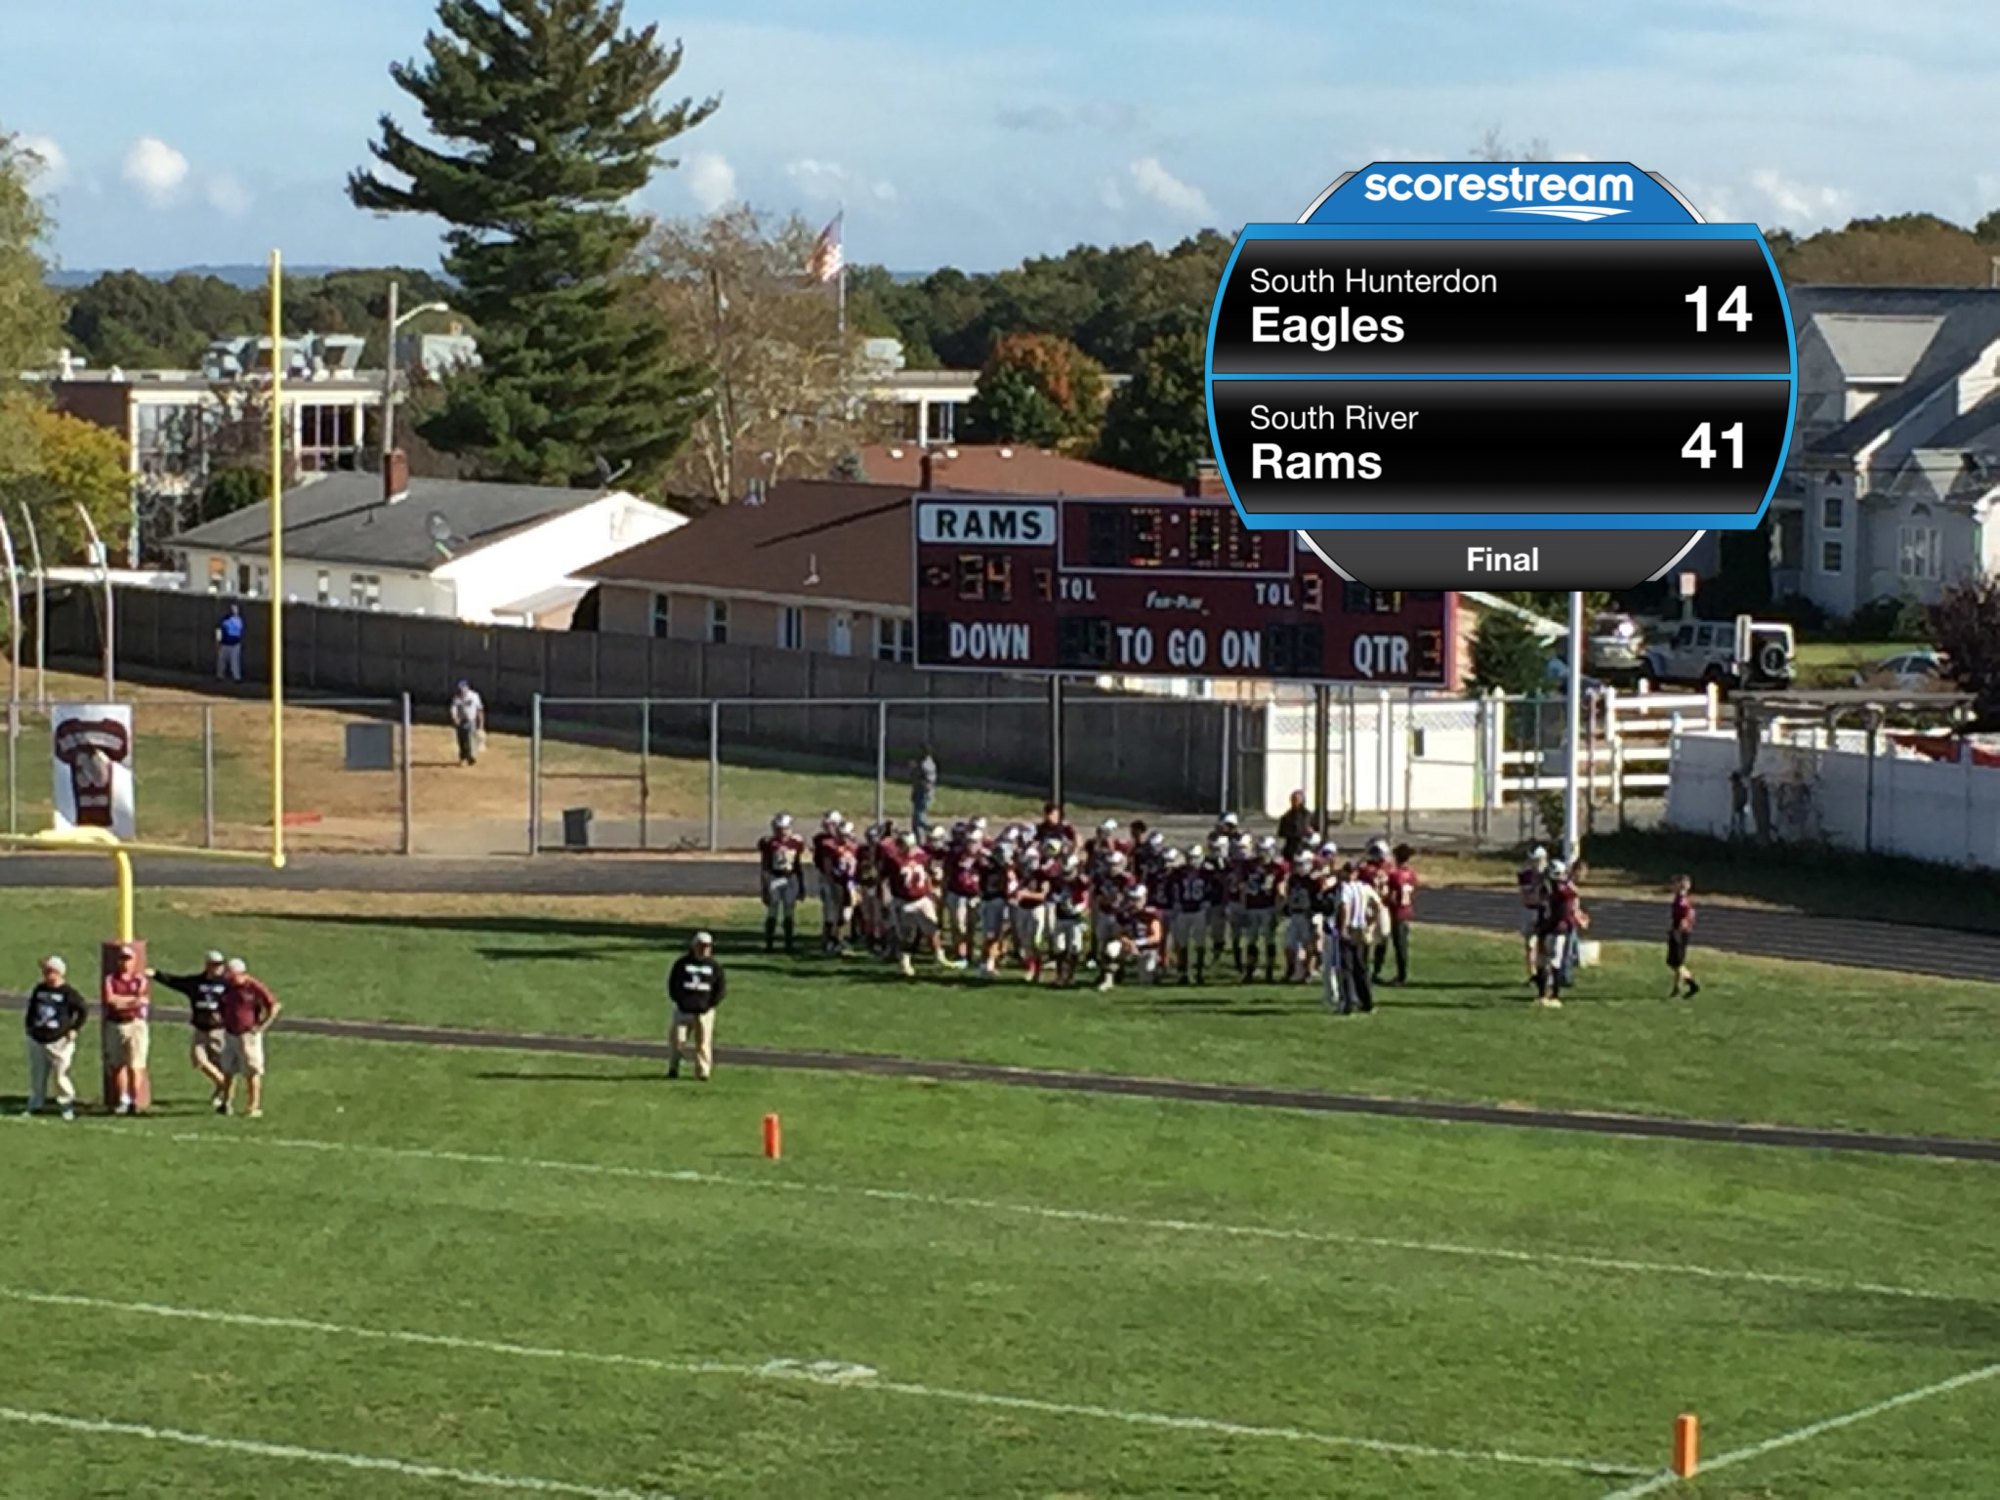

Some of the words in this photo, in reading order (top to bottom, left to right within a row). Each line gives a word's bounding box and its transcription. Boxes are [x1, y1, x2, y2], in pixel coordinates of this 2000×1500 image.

[936, 509, 1042, 540] RAMS
[1059, 577, 1097, 601] TOL
[1255, 582, 1295, 607] TOL
[949, 622, 1031, 661] DOWN
[1117, 627, 1155, 667] TO
[1167, 628, 1207, 667] GO
[1222, 630, 1262, 670] ON
[1353, 634, 1410, 679] QTR
